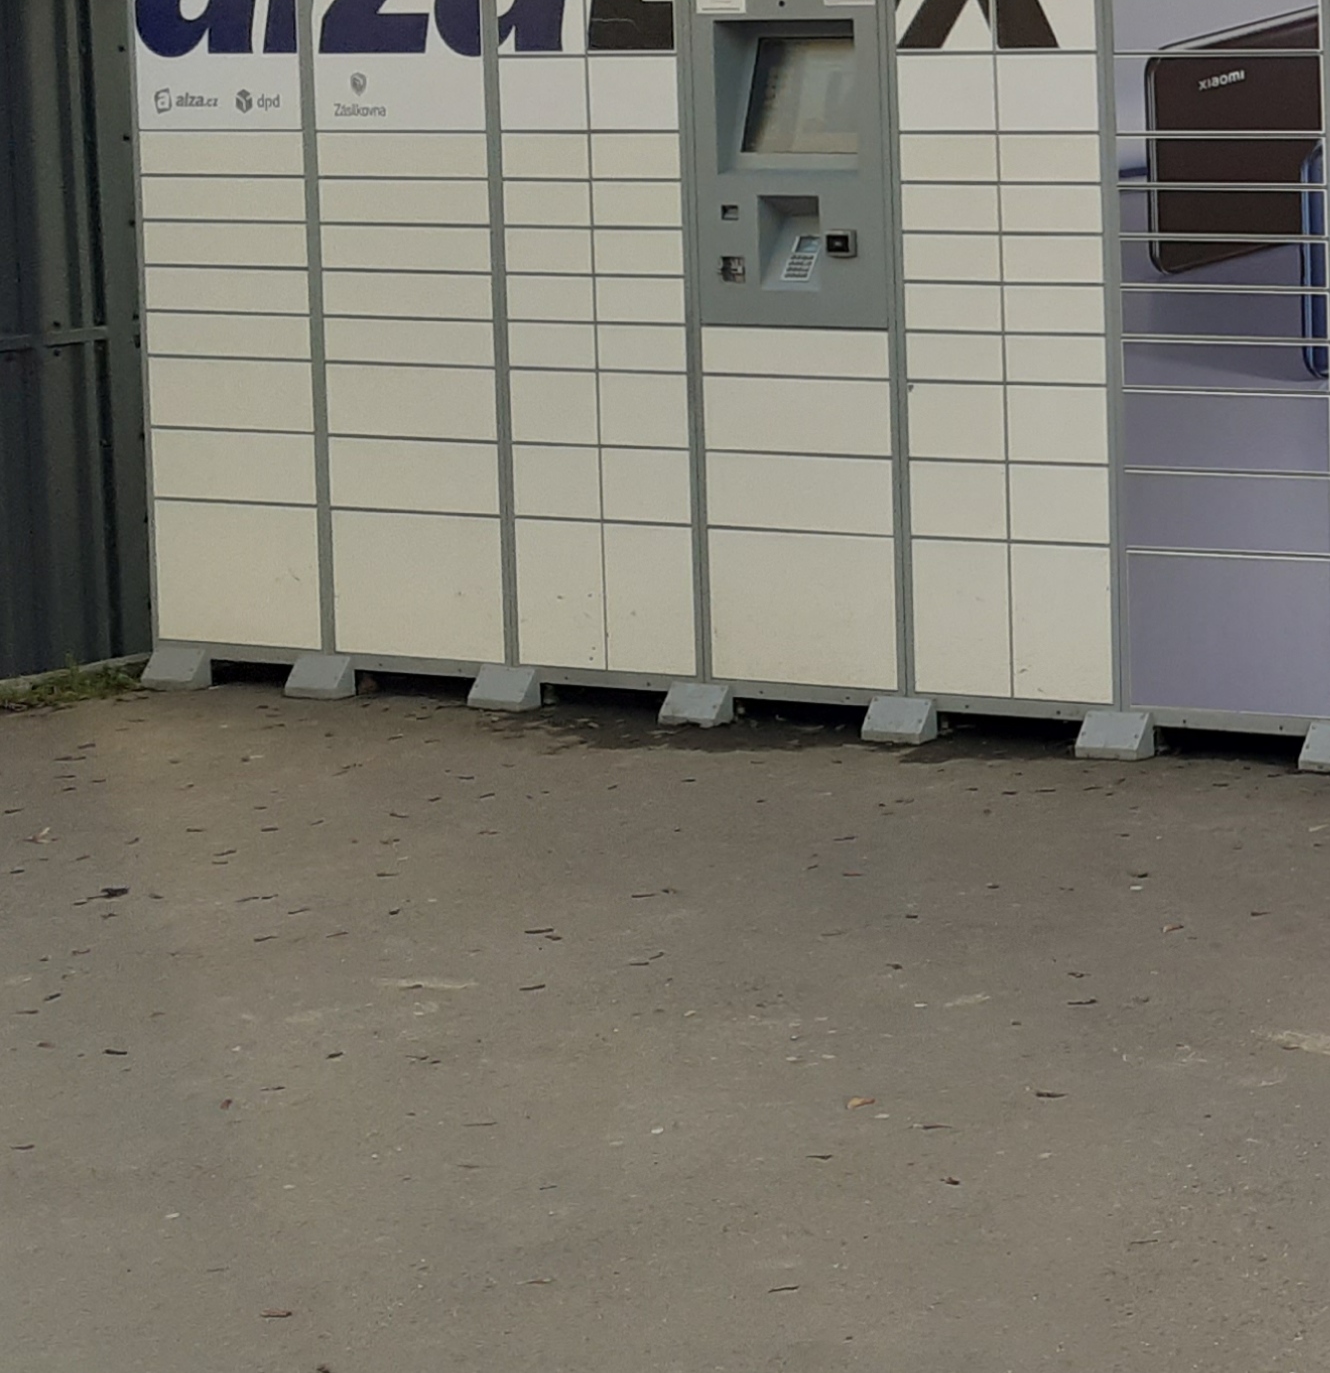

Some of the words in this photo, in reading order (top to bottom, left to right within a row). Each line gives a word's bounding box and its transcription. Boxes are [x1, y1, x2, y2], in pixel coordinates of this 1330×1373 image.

[175, 93, 219, 107] alza.cz
[257, 94, 281, 110] dpd
[334, 103, 387, 117] Zásilkovna
